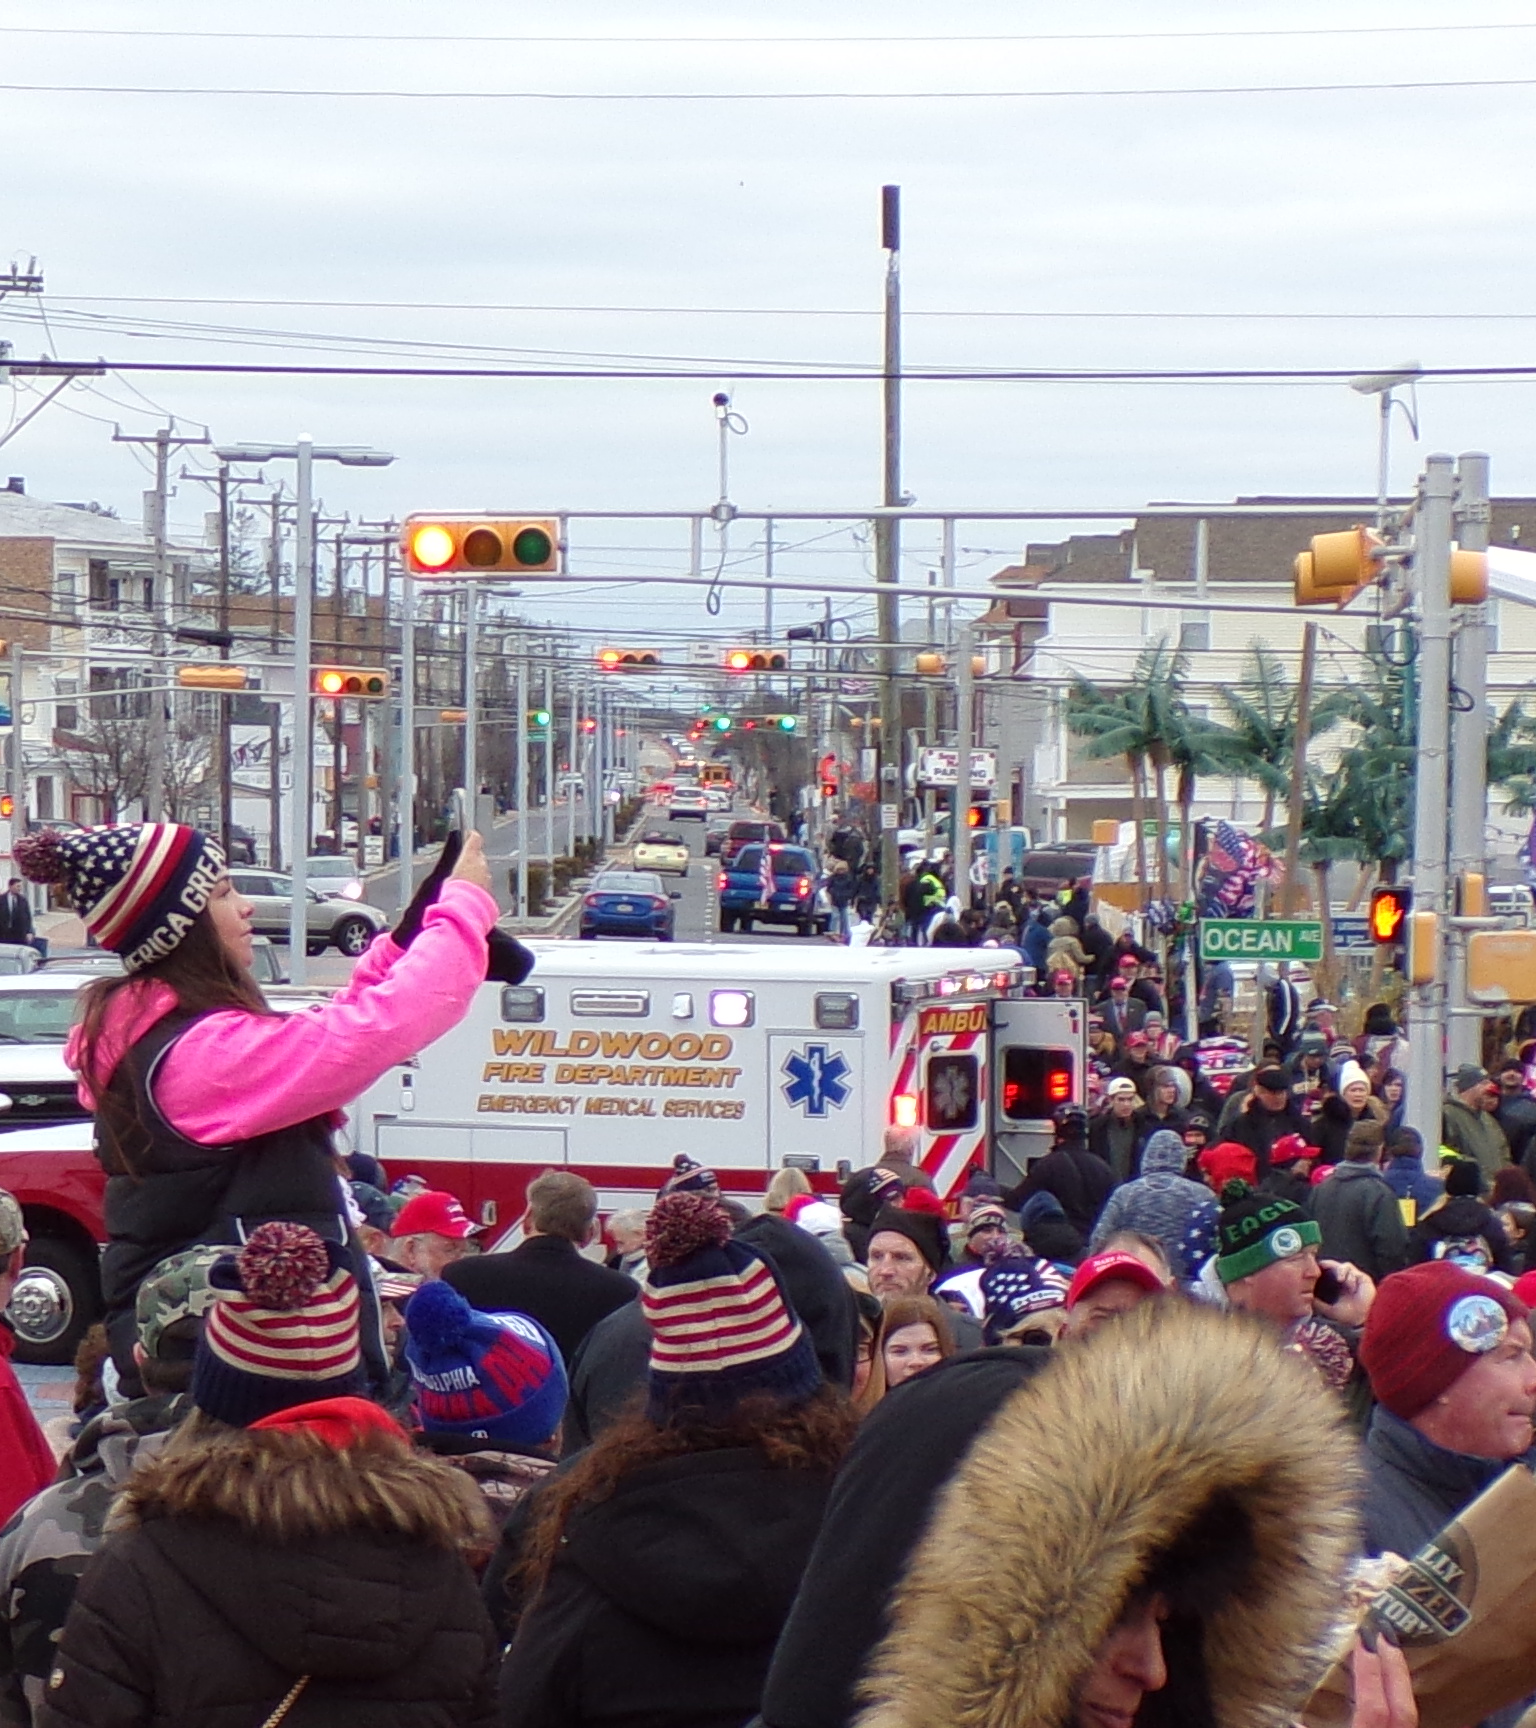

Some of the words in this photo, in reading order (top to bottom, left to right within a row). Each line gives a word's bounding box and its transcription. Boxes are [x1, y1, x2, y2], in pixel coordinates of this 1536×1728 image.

[123, 912, 195, 974] ERICA
[180, 837, 228, 914] GREA
[1205, 928, 1293, 952] OCEAN
[1299, 930, 1322, 943] AVE
[923, 1010, 987, 1034] AMBU
[492, 1029, 733, 1060] WILDWOOD
[482, 1062, 546, 1082] FIRE
[554, 1064, 742, 1088] DEPARTMENT
[477, 1094, 581, 1115] EMERGENCY
[584, 1097, 656, 1117] MEDICAL
[663, 1100, 745, 1119] SERVICES
